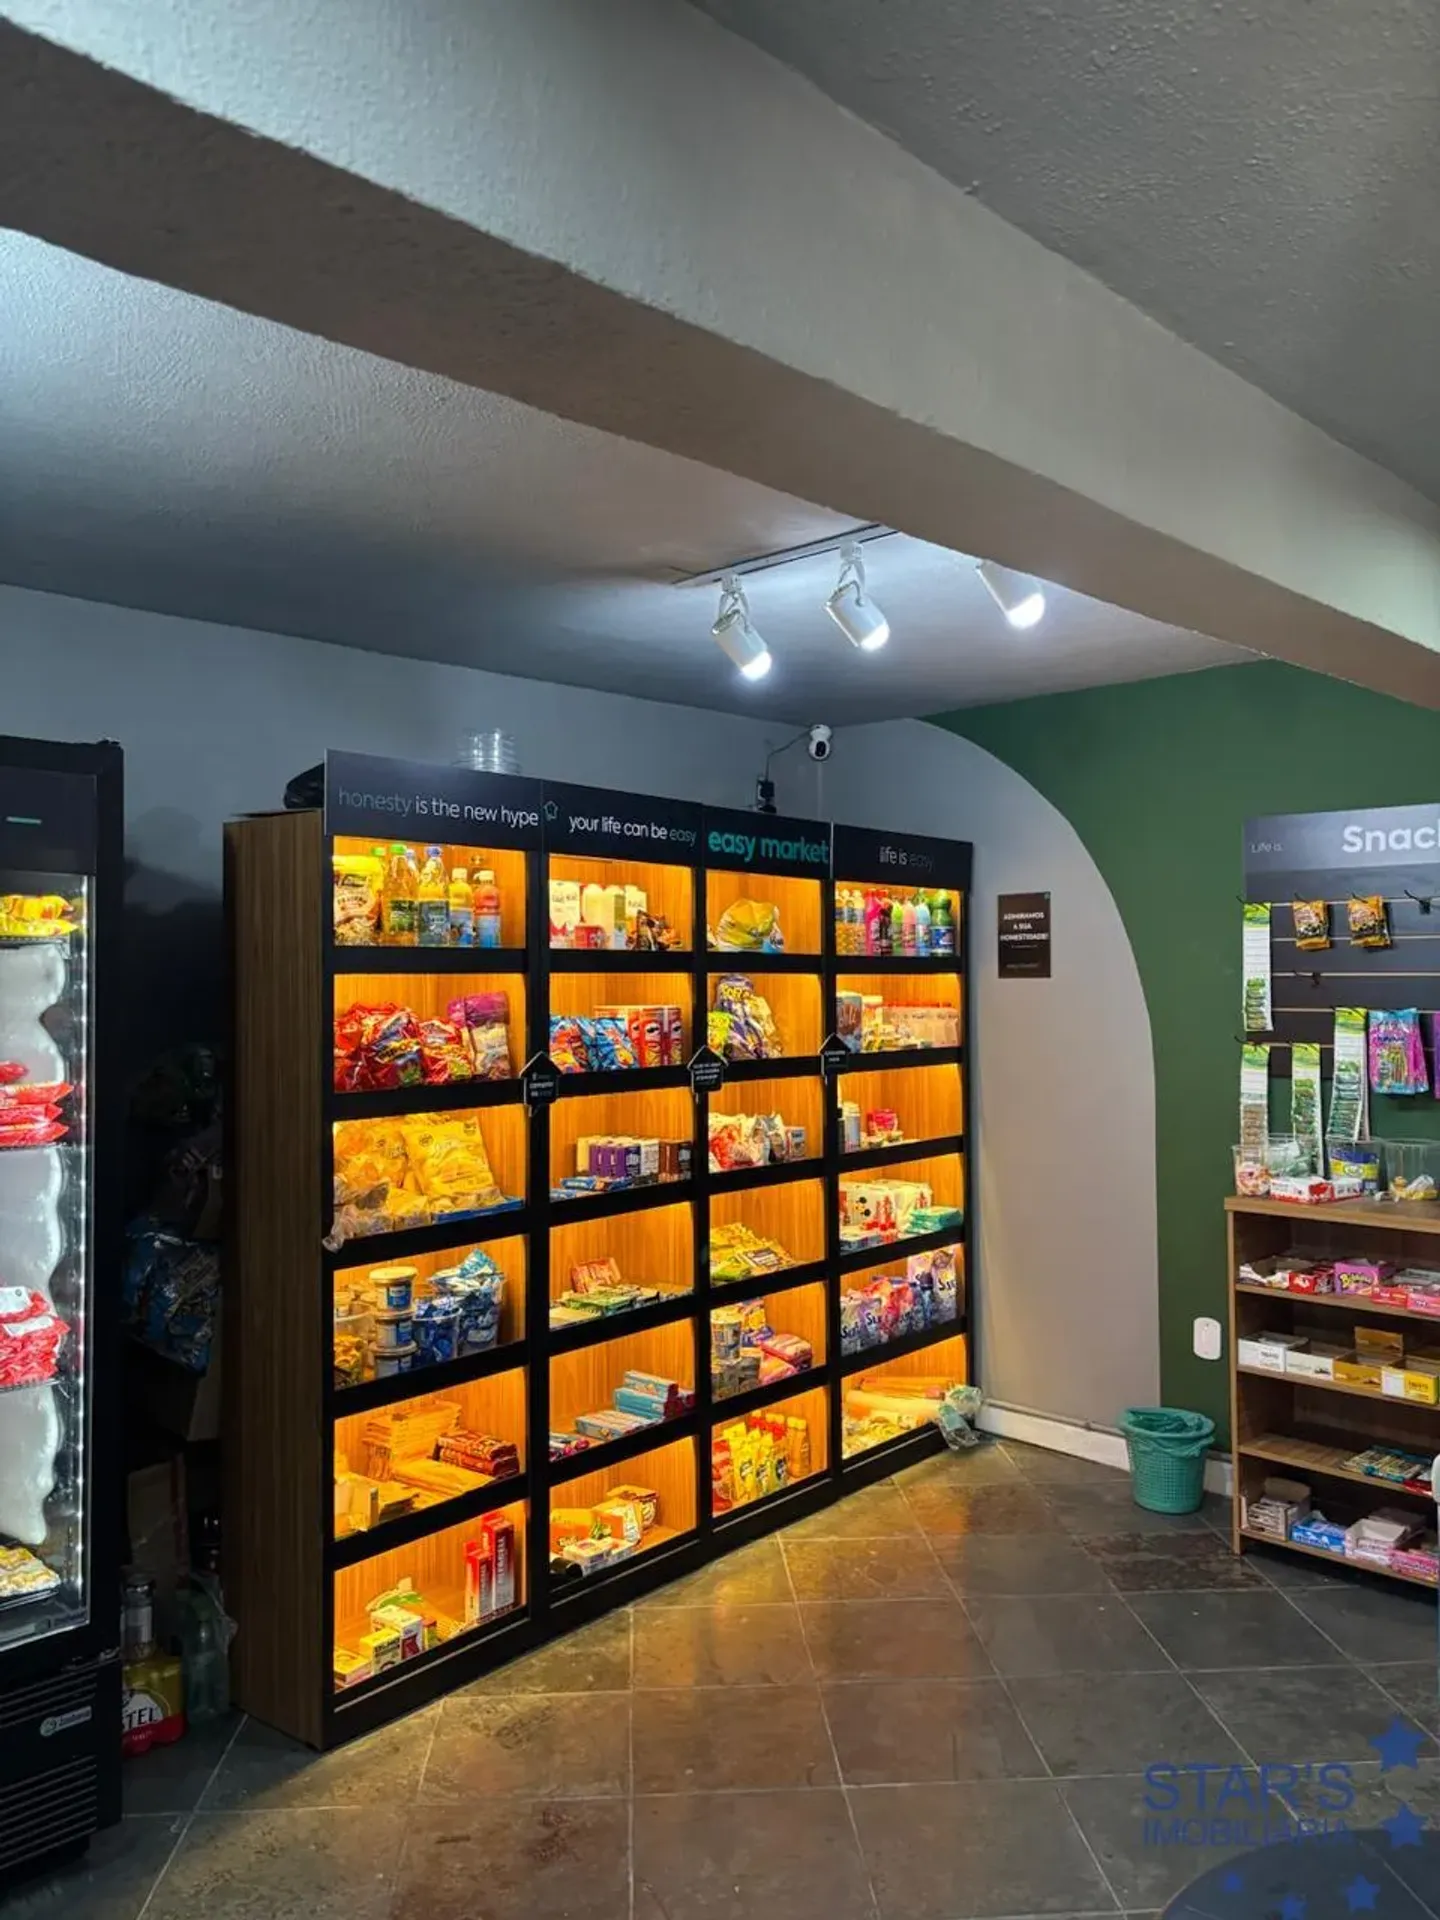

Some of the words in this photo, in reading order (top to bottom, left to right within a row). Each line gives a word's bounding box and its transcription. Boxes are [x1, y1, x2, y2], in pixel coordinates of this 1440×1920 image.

[338, 787, 413, 817] honesty
[415, 796, 428, 815] is
[431, 799, 460, 818] the
[464, 805, 497, 822] new
[501, 807, 539, 828] hype
[569, 815, 599, 833] your
[601, 816, 621, 834] life
[623, 822, 649, 838] can
[651, 822, 668, 840] be
[669, 828, 697, 847] easy
[708, 830, 755, 863] easy
[761, 836, 829, 864] market
[1342, 819, 1440, 854] Snac
[880, 846, 897, 864] life
[898, 848, 908, 865] is
[122, 1707, 157, 1731] TEL
